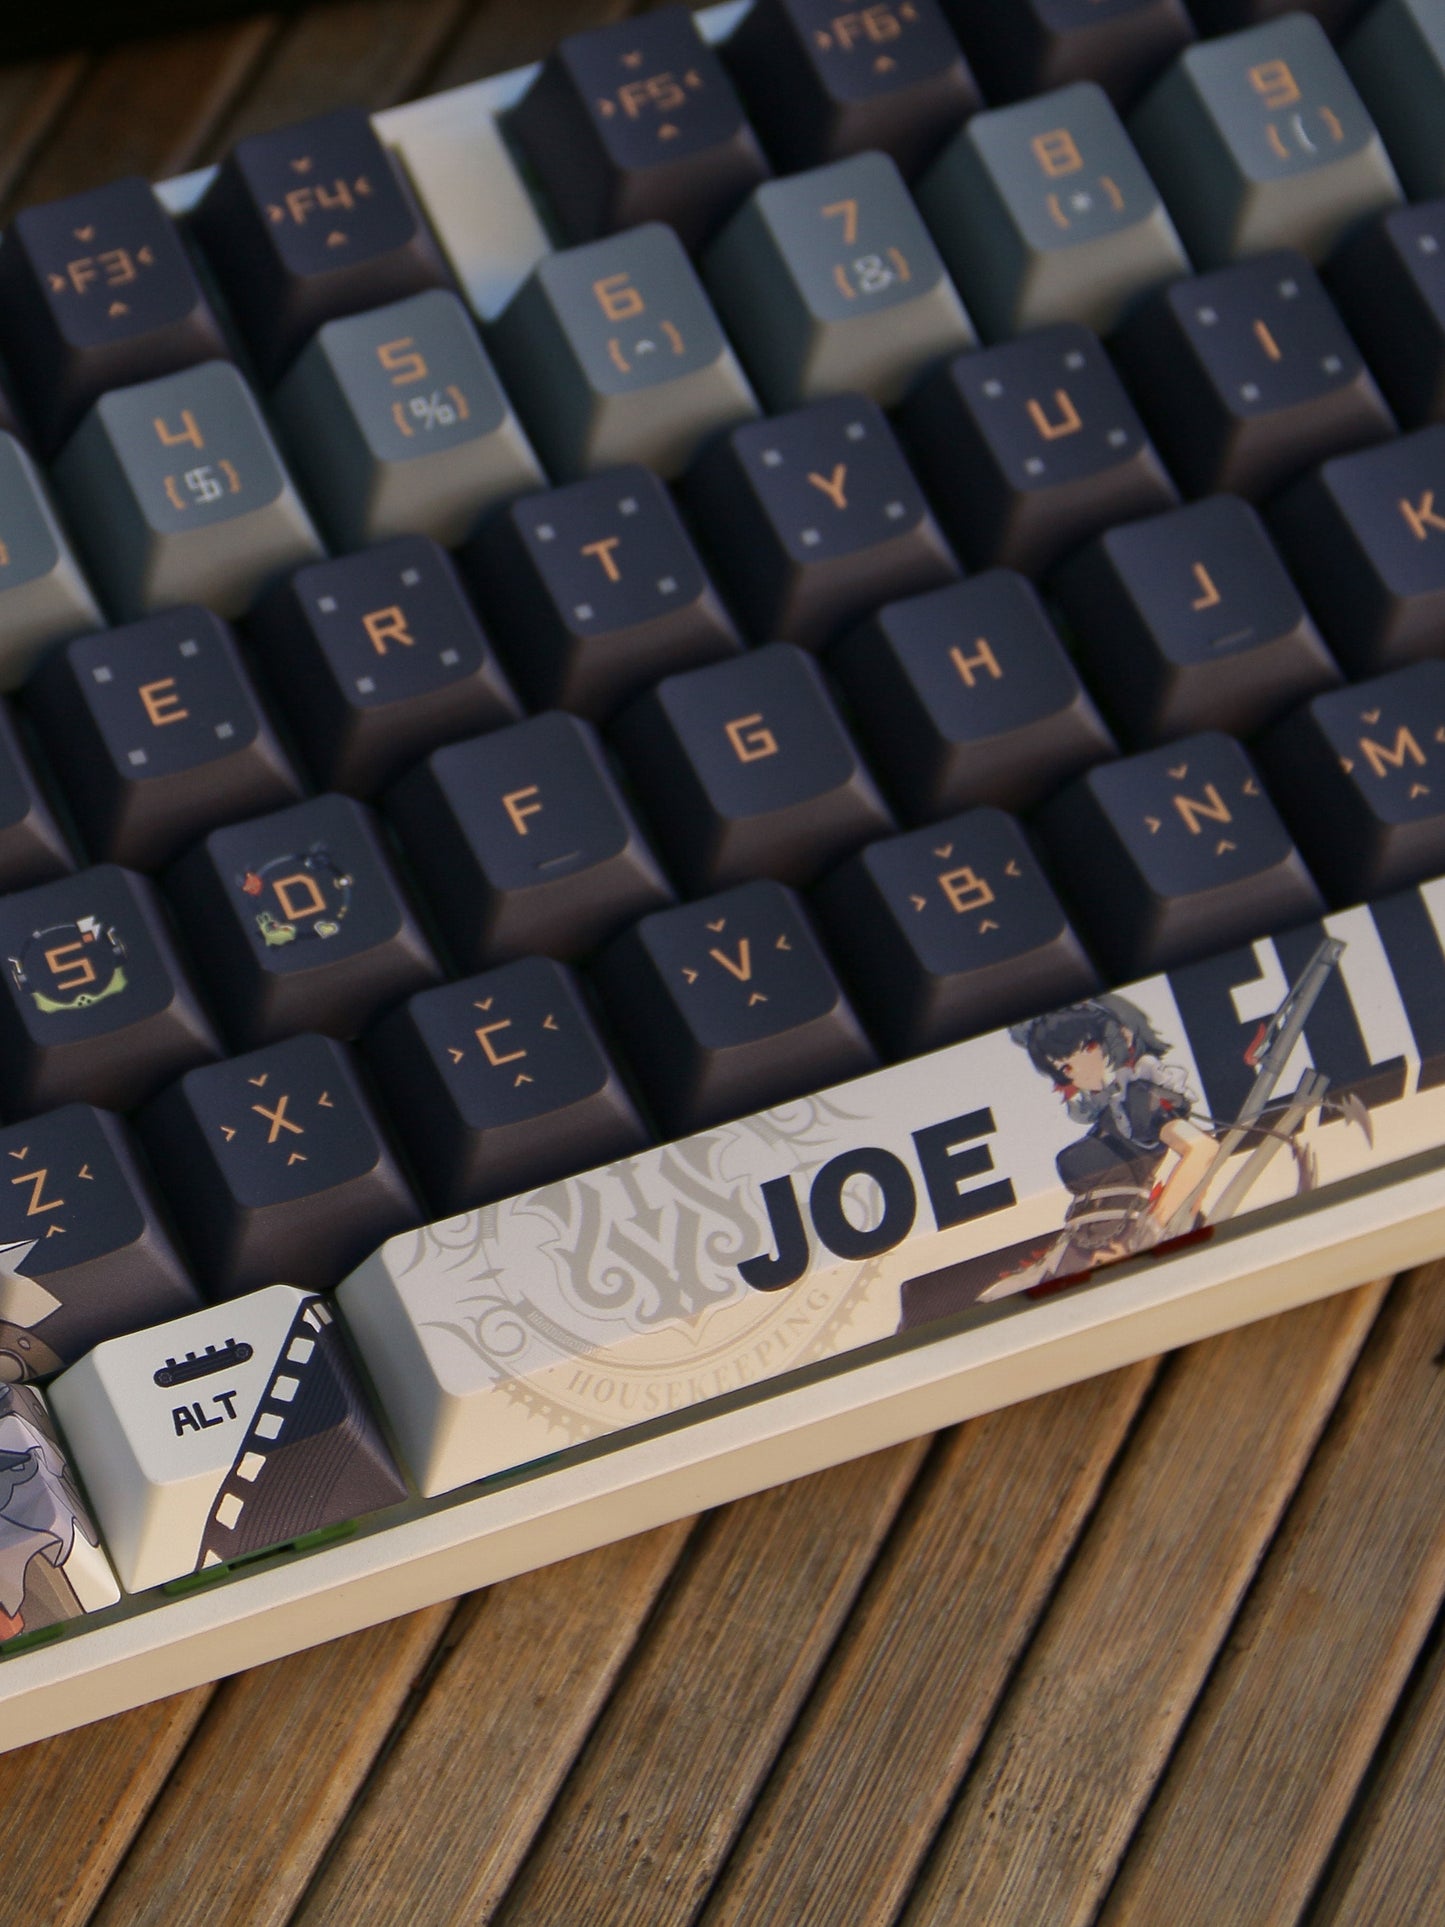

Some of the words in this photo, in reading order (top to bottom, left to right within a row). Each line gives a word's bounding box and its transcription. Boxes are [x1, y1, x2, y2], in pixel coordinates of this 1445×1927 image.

[1249, 60, 1301, 107] 9
[1032, 129, 1083, 177] 8
[823, 199, 858, 244] 7
[592, 273, 645, 321] 6
[377, 338, 427, 385] 5
[154, 410, 204, 449] 4
[1026, 390, 1082, 440] U
[809, 464, 847, 508] Y
[1400, 491, 1445, 539] K
[582, 537, 620, 581] T
[1193, 563, 1220, 610] J
[362, 606, 413, 655] R
[950, 639, 1002, 687] H
[138, 678, 188, 726] E
[724, 713, 778, 763] G
[1359, 726, 1426, 777] M
[502, 785, 541, 836] F
[1173, 784, 1231, 834] N
[272, 873, 326, 920] D
[938, 866, 995, 913] B
[44, 942, 96, 990] S
[710, 939, 751, 981] V
[475, 1018, 526, 1066] C
[252, 1095, 303, 1143] X
[12, 1168, 64, 1216] Z
[736, 1106, 1018, 1293] JOE
[566, 1287, 830, 1412] HOUSEKEEPING
[171, 1389, 238, 1437] ALT
